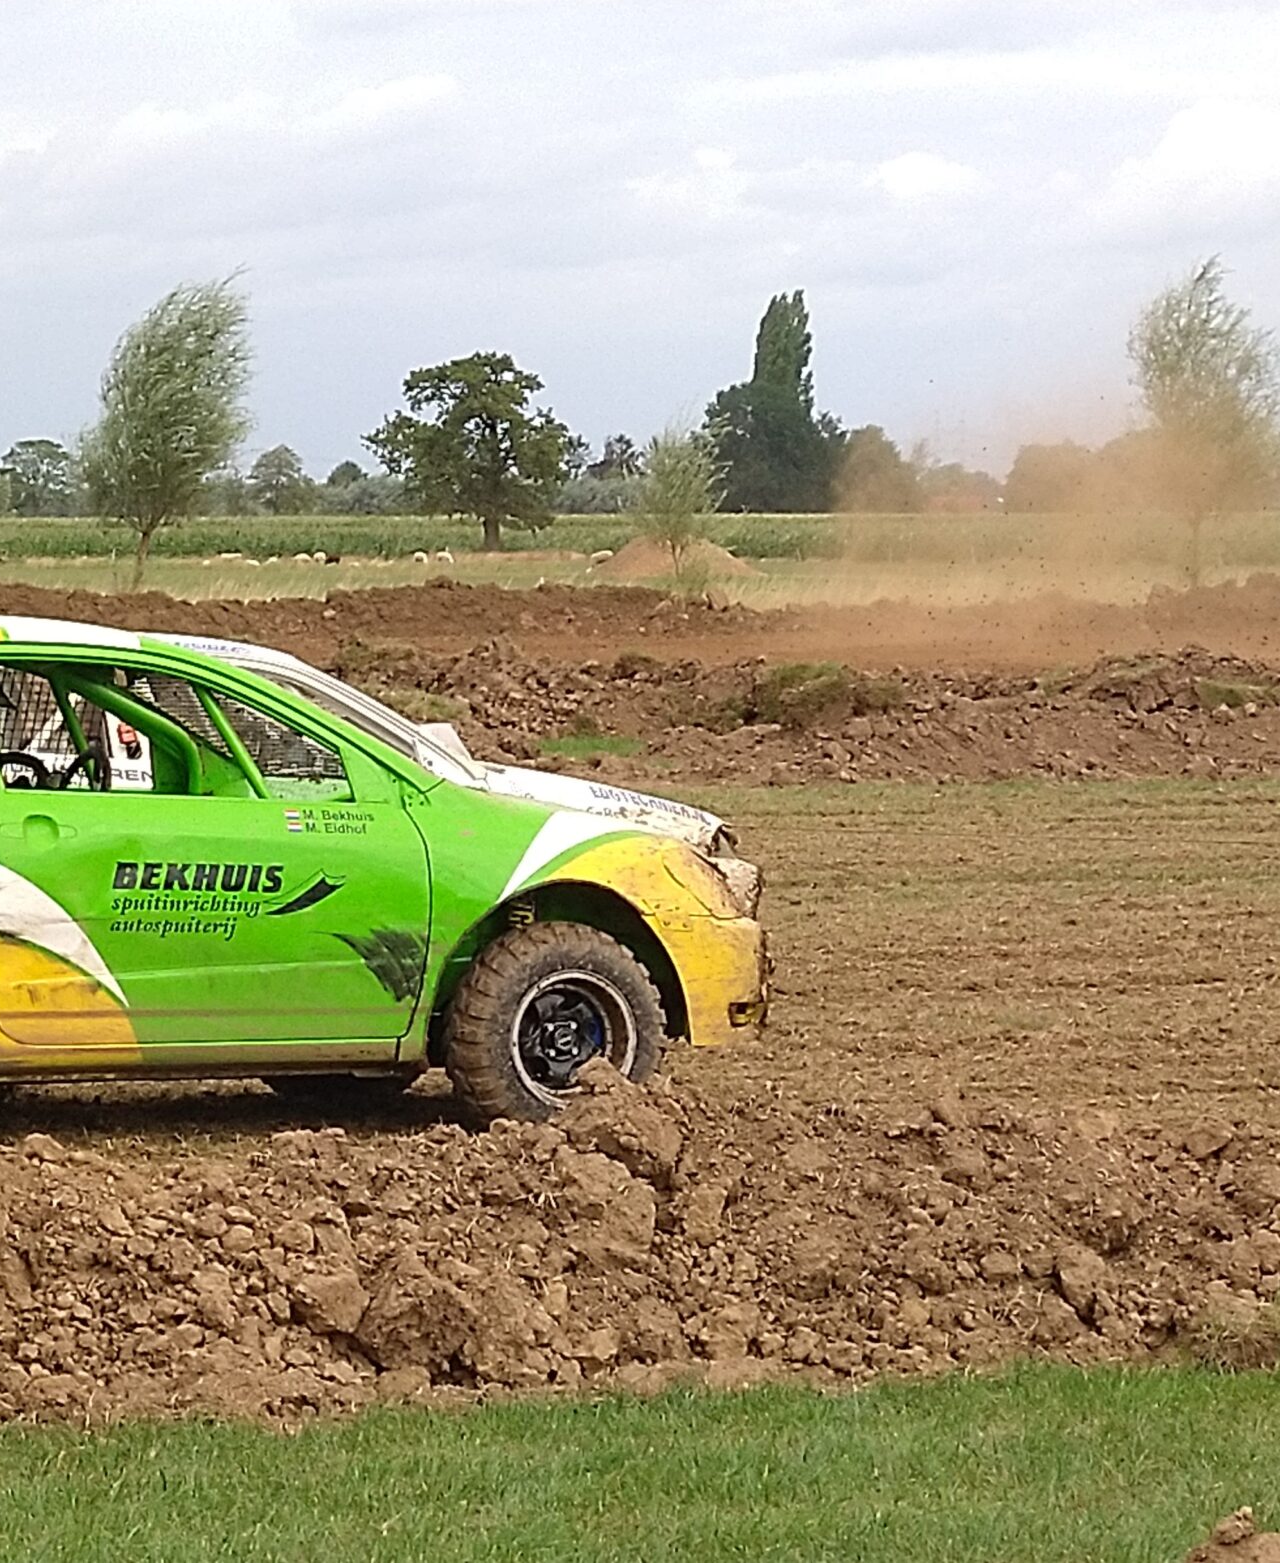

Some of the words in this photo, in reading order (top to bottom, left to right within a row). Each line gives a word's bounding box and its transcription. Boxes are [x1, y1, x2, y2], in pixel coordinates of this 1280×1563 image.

[321, 810, 376, 822] Bekhuis
[112, 861, 286, 894] BEKHUIS
[110, 893, 262, 919] spuitinrichting
[109, 916, 238, 942] autospuiterij
